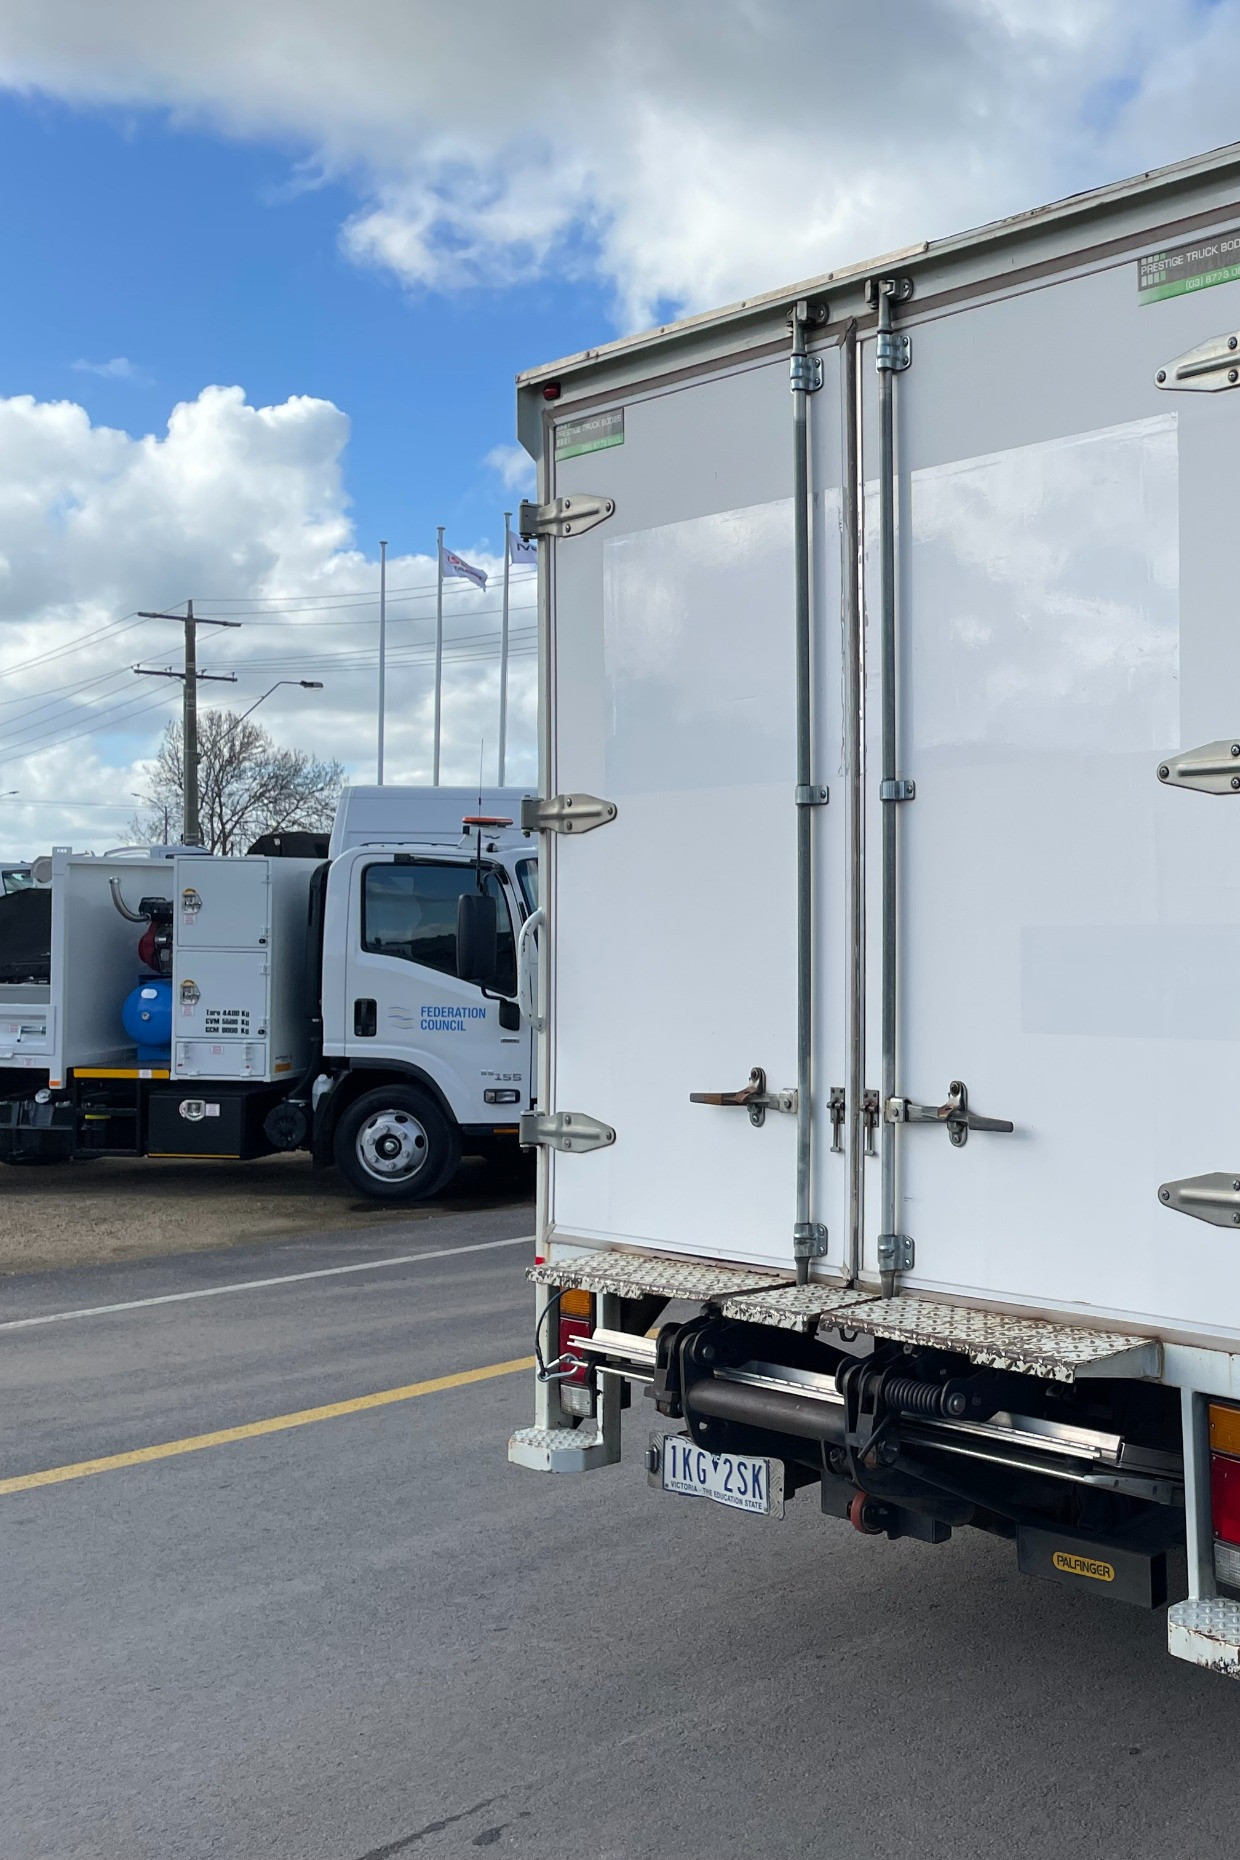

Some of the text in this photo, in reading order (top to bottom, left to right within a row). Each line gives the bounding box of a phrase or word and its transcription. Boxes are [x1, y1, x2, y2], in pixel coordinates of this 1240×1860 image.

[1140, 254, 1184, 276] PRESTIGE
[1186, 245, 1219, 262] TRUCK
[1186, 277, 1204, 291] (03)
[420, 1006, 487, 1019] FEDERATION
[420, 1019, 467, 1031] COUNCIL
[671, 1445, 763, 1500] 1KG 2SK
[670, 1480, 698, 1492] VICTORIA
[702, 1487, 713, 1497] THE
[713, 1490, 743, 1506] EDUCATION
[744, 1500, 763, 1510] STATE
[1056, 1554, 1111, 1578] PALFINGER
